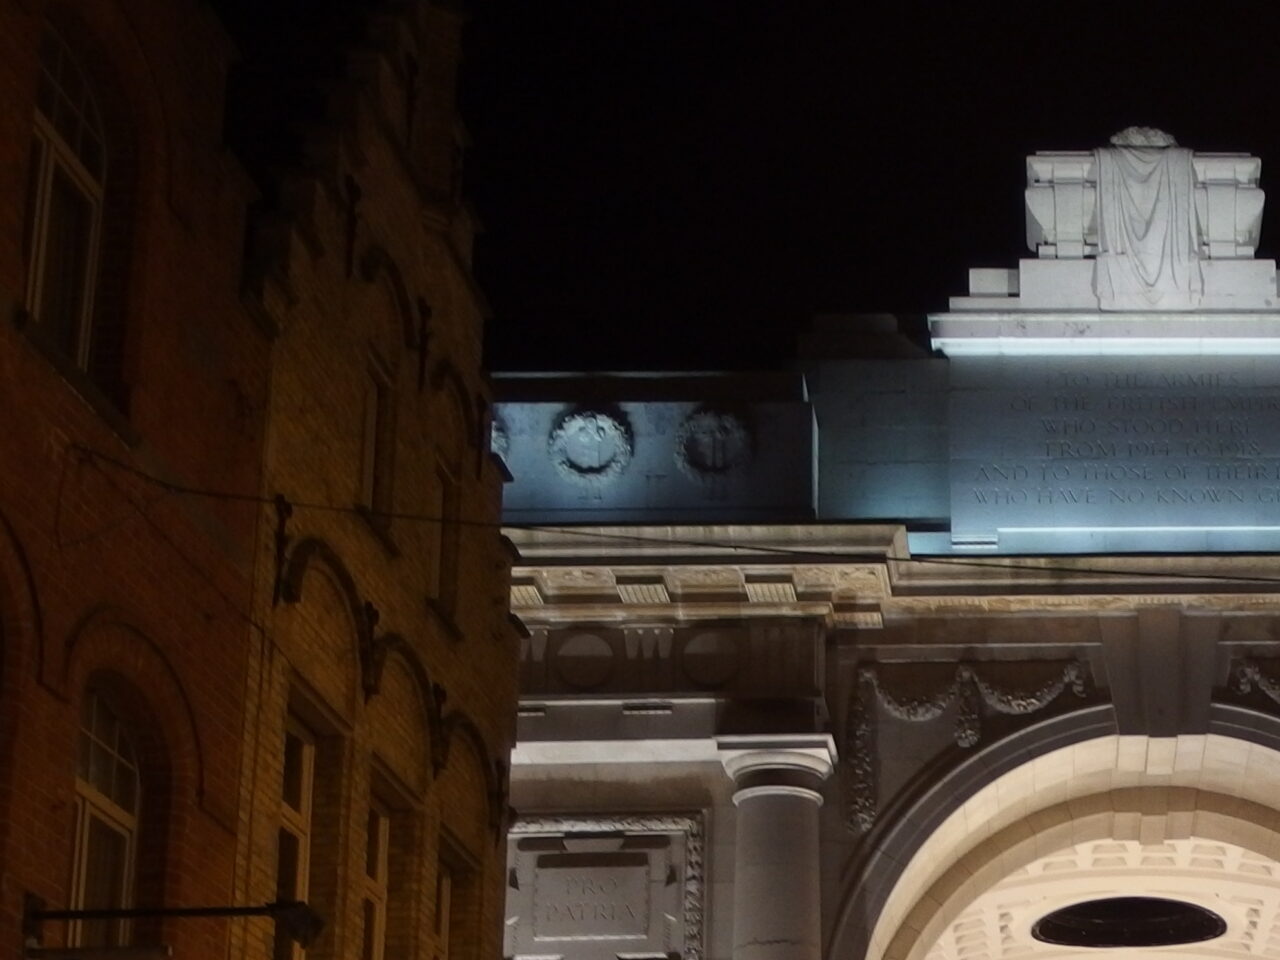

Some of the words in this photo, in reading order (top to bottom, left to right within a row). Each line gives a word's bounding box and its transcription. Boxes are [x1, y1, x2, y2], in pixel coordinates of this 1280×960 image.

[1040, 416, 1097, 434] WHO
[1107, 416, 1184, 434] STOOD
[1044, 439, 1117, 457] FROM
[974, 463, 1029, 481] AND
[1039, 463, 1071, 481] TO
[1082, 462, 1152, 481] THOSE
[1164, 462, 1194, 480] OF
[1205, 462, 1271, 480] THEIR
[972, 487, 1028, 504] WHO
[1108, 487, 1146, 504] NO
[1156, 487, 1247, 504] KNOWN
[565, 875, 618, 895] PRO
[546, 902, 637, 921] PATRIA
